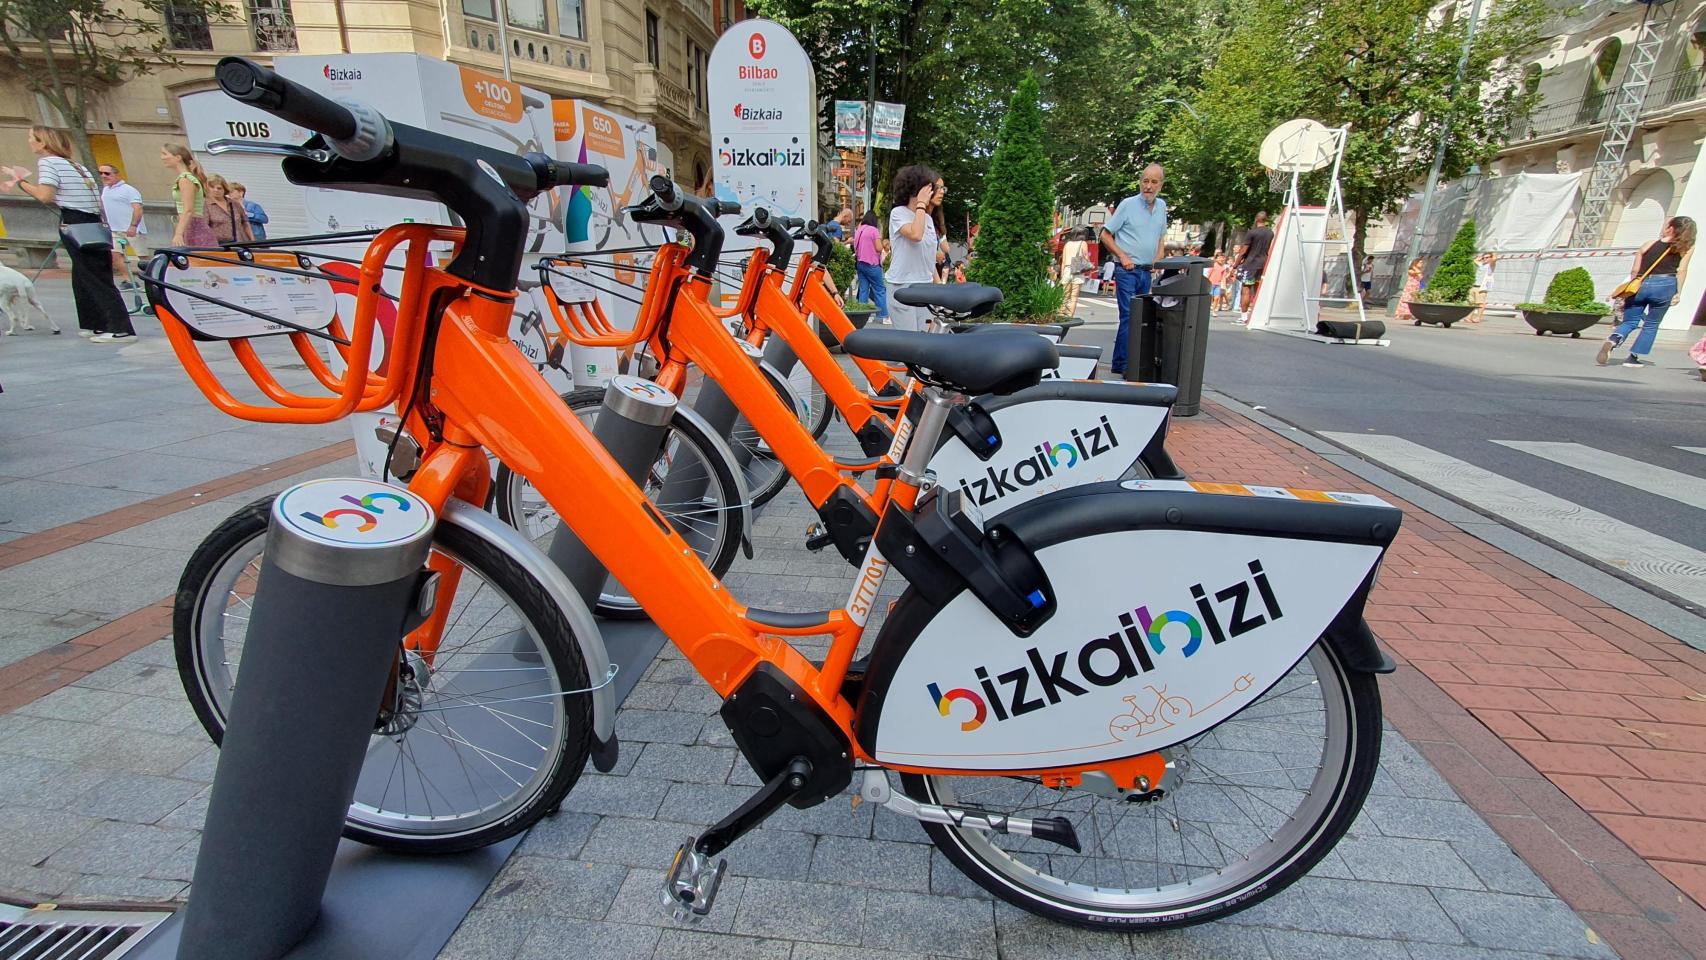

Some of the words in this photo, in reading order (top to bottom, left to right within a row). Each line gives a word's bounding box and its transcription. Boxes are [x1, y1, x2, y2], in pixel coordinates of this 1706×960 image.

[752, 39, 764, 54] B
[330, 68, 362, 81] Bizkaia
[739, 65, 778, 80] Bilbao
[475, 80, 512, 104] +100
[742, 108, 782, 121] Bizkaia
[226, 121, 271, 138] TOUS
[592, 116, 612, 134] 650
[719, 148, 805, 167] bizkaibizi
[851, 557, 887, 616] 377701
[926, 559, 1284, 731] bizkaibizi
[1225, 884, 1268, 908] SCHWALBE
[1162, 914, 1185, 923] DELTA
